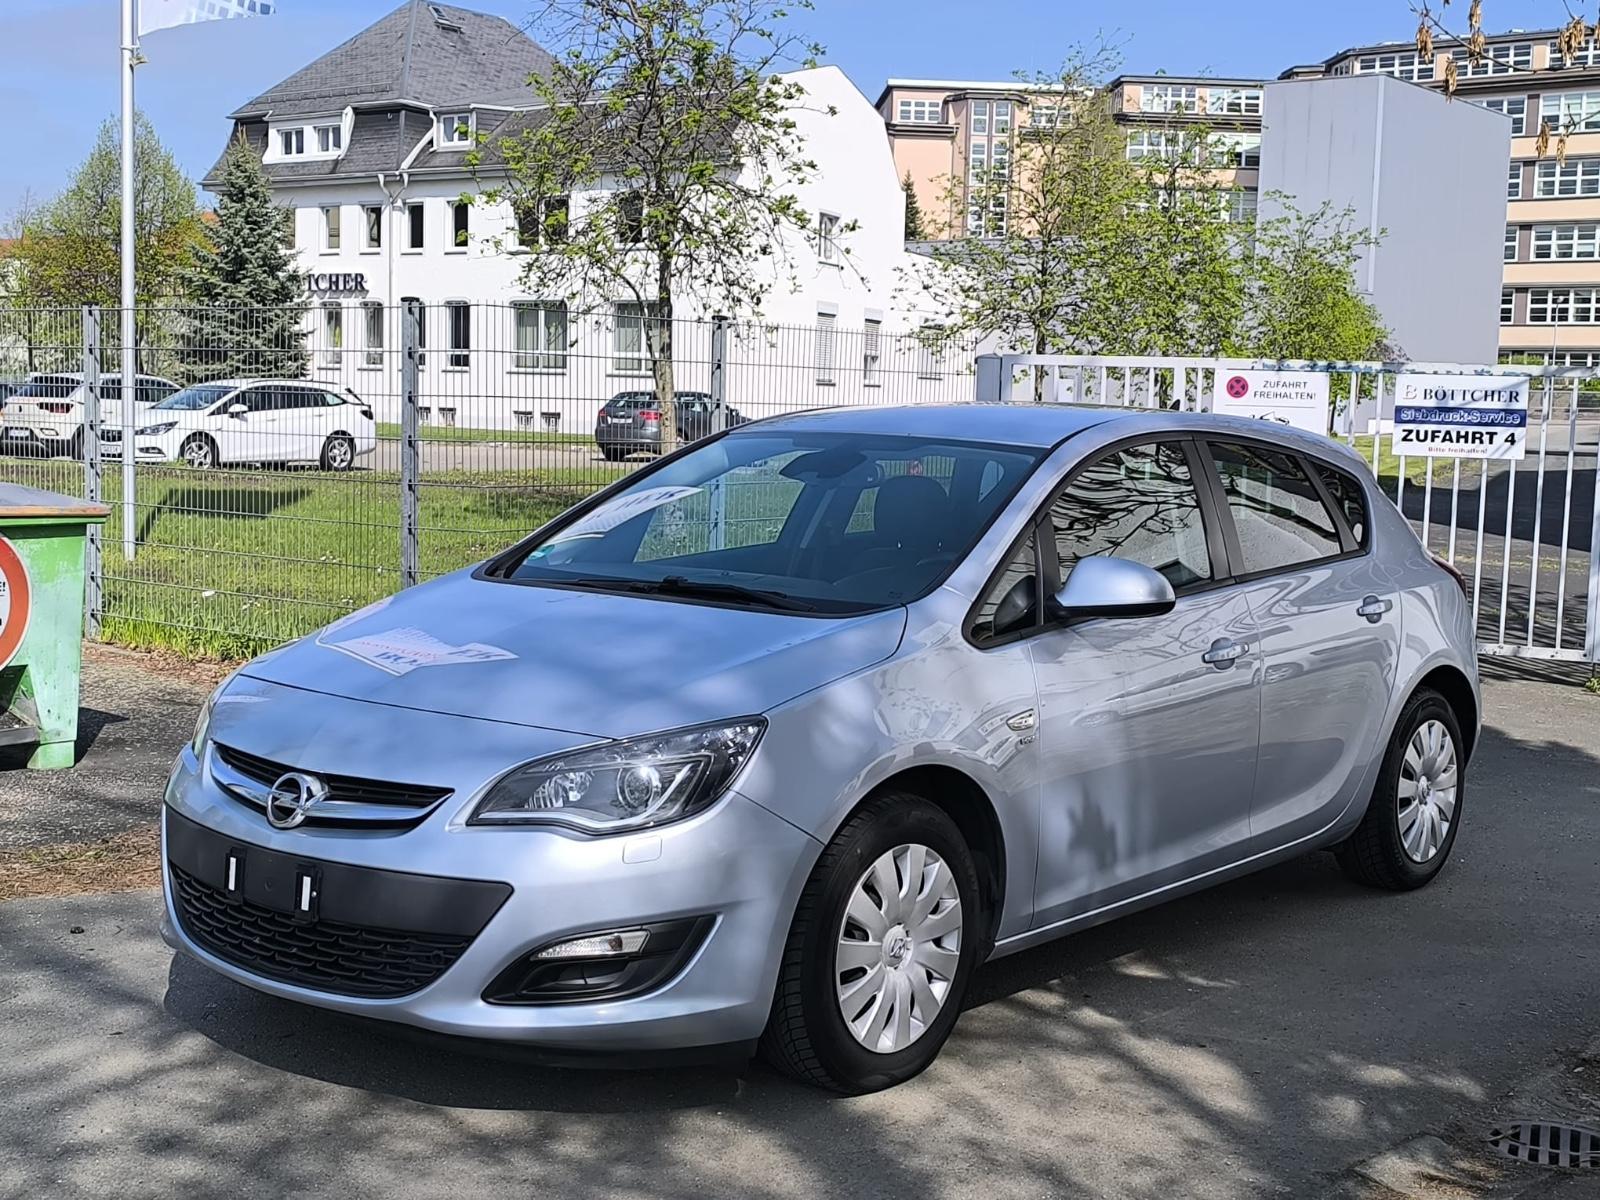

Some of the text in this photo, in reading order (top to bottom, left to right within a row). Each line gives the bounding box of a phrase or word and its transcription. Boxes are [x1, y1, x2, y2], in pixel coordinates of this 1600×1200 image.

[1263, 380, 1308, 389] ZUFAHRT
[1253, 390, 1317, 400] FREIHALTEN!
[1423, 385, 1520, 403] BÖTTCHER
[1400, 408, 1521, 424] Siebdruck-Service
[1401, 429, 1517, 446] ZUFAHRT 4
